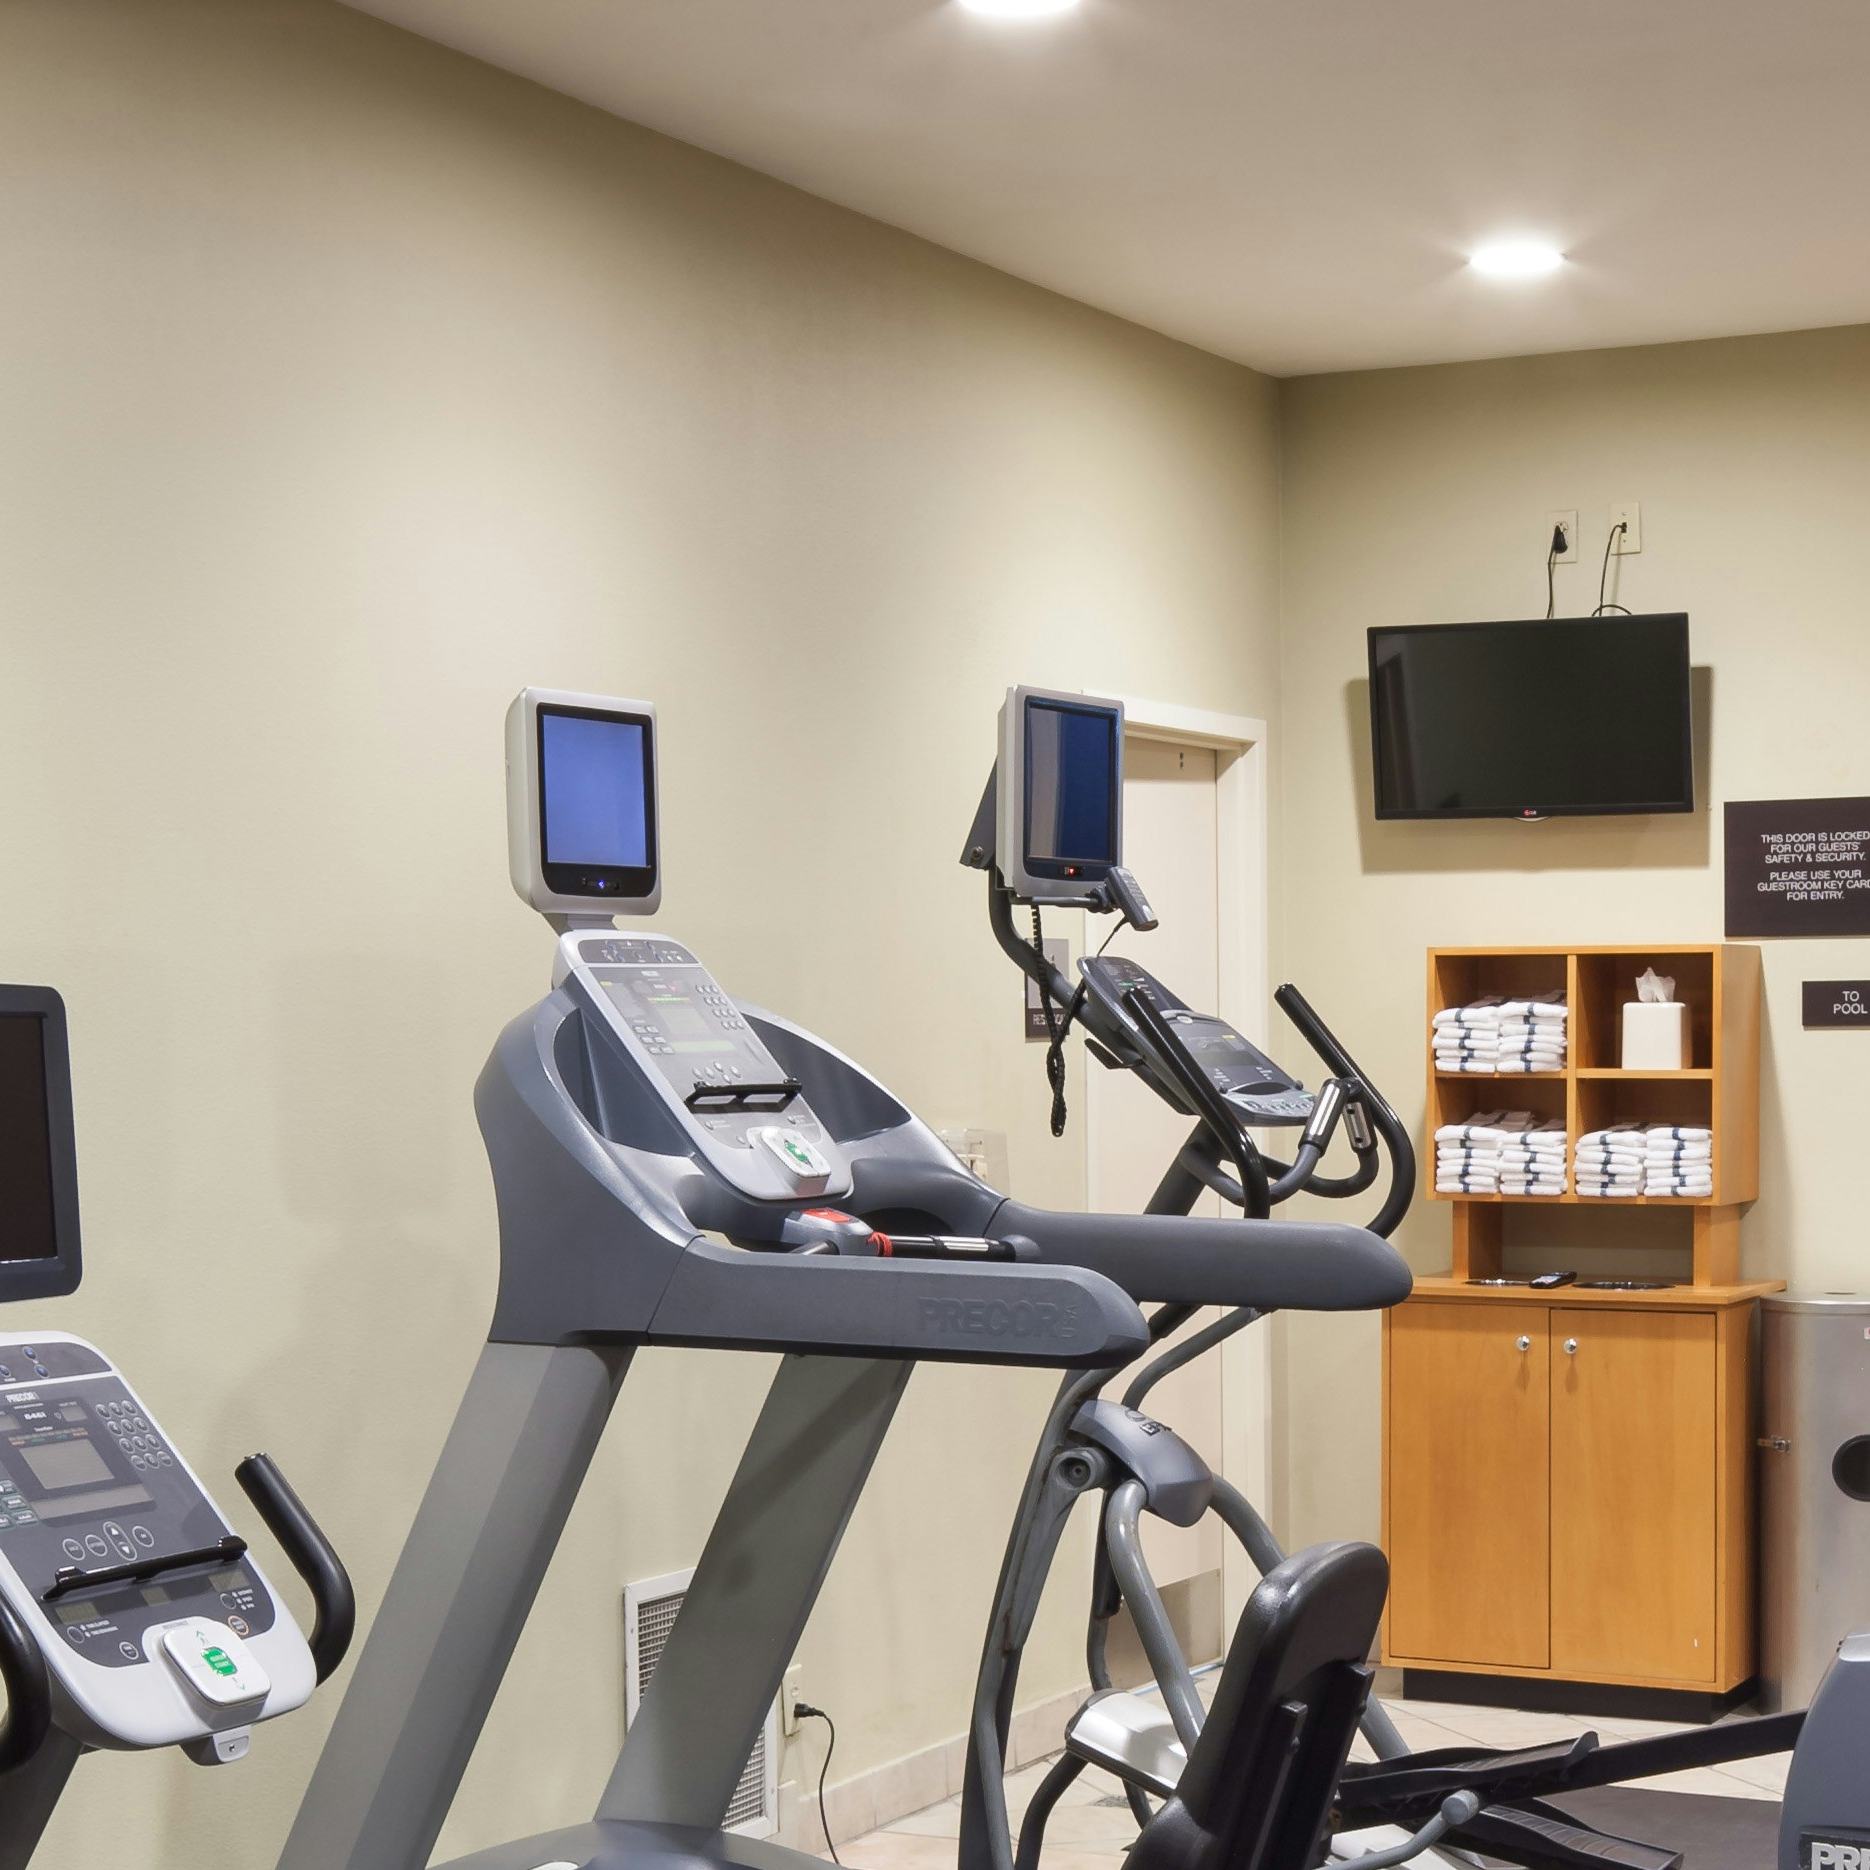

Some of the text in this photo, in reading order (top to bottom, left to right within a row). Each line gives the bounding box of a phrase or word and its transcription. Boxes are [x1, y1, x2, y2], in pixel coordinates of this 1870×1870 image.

[1761, 831, 1870, 844] THIS DOOR IS LOCKED
[1770, 843, 1792, 853] FOR
[1794, 843, 1817, 853] OUR
[1765, 851, 1867, 864] SAFETY & SECURITY.
[1770, 869, 1862, 881] PLEASE USE YOUR
[1757, 881, 1822, 892] GUESTROOM
[1824, 880, 1844, 890] KEY
[1787, 891, 1845, 901] FOR ENTRY.
[1842, 991, 1860, 1002] TO
[1833, 1003, 1868, 1015] POOL
[918, 1296, 1059, 1338] PRECOR
